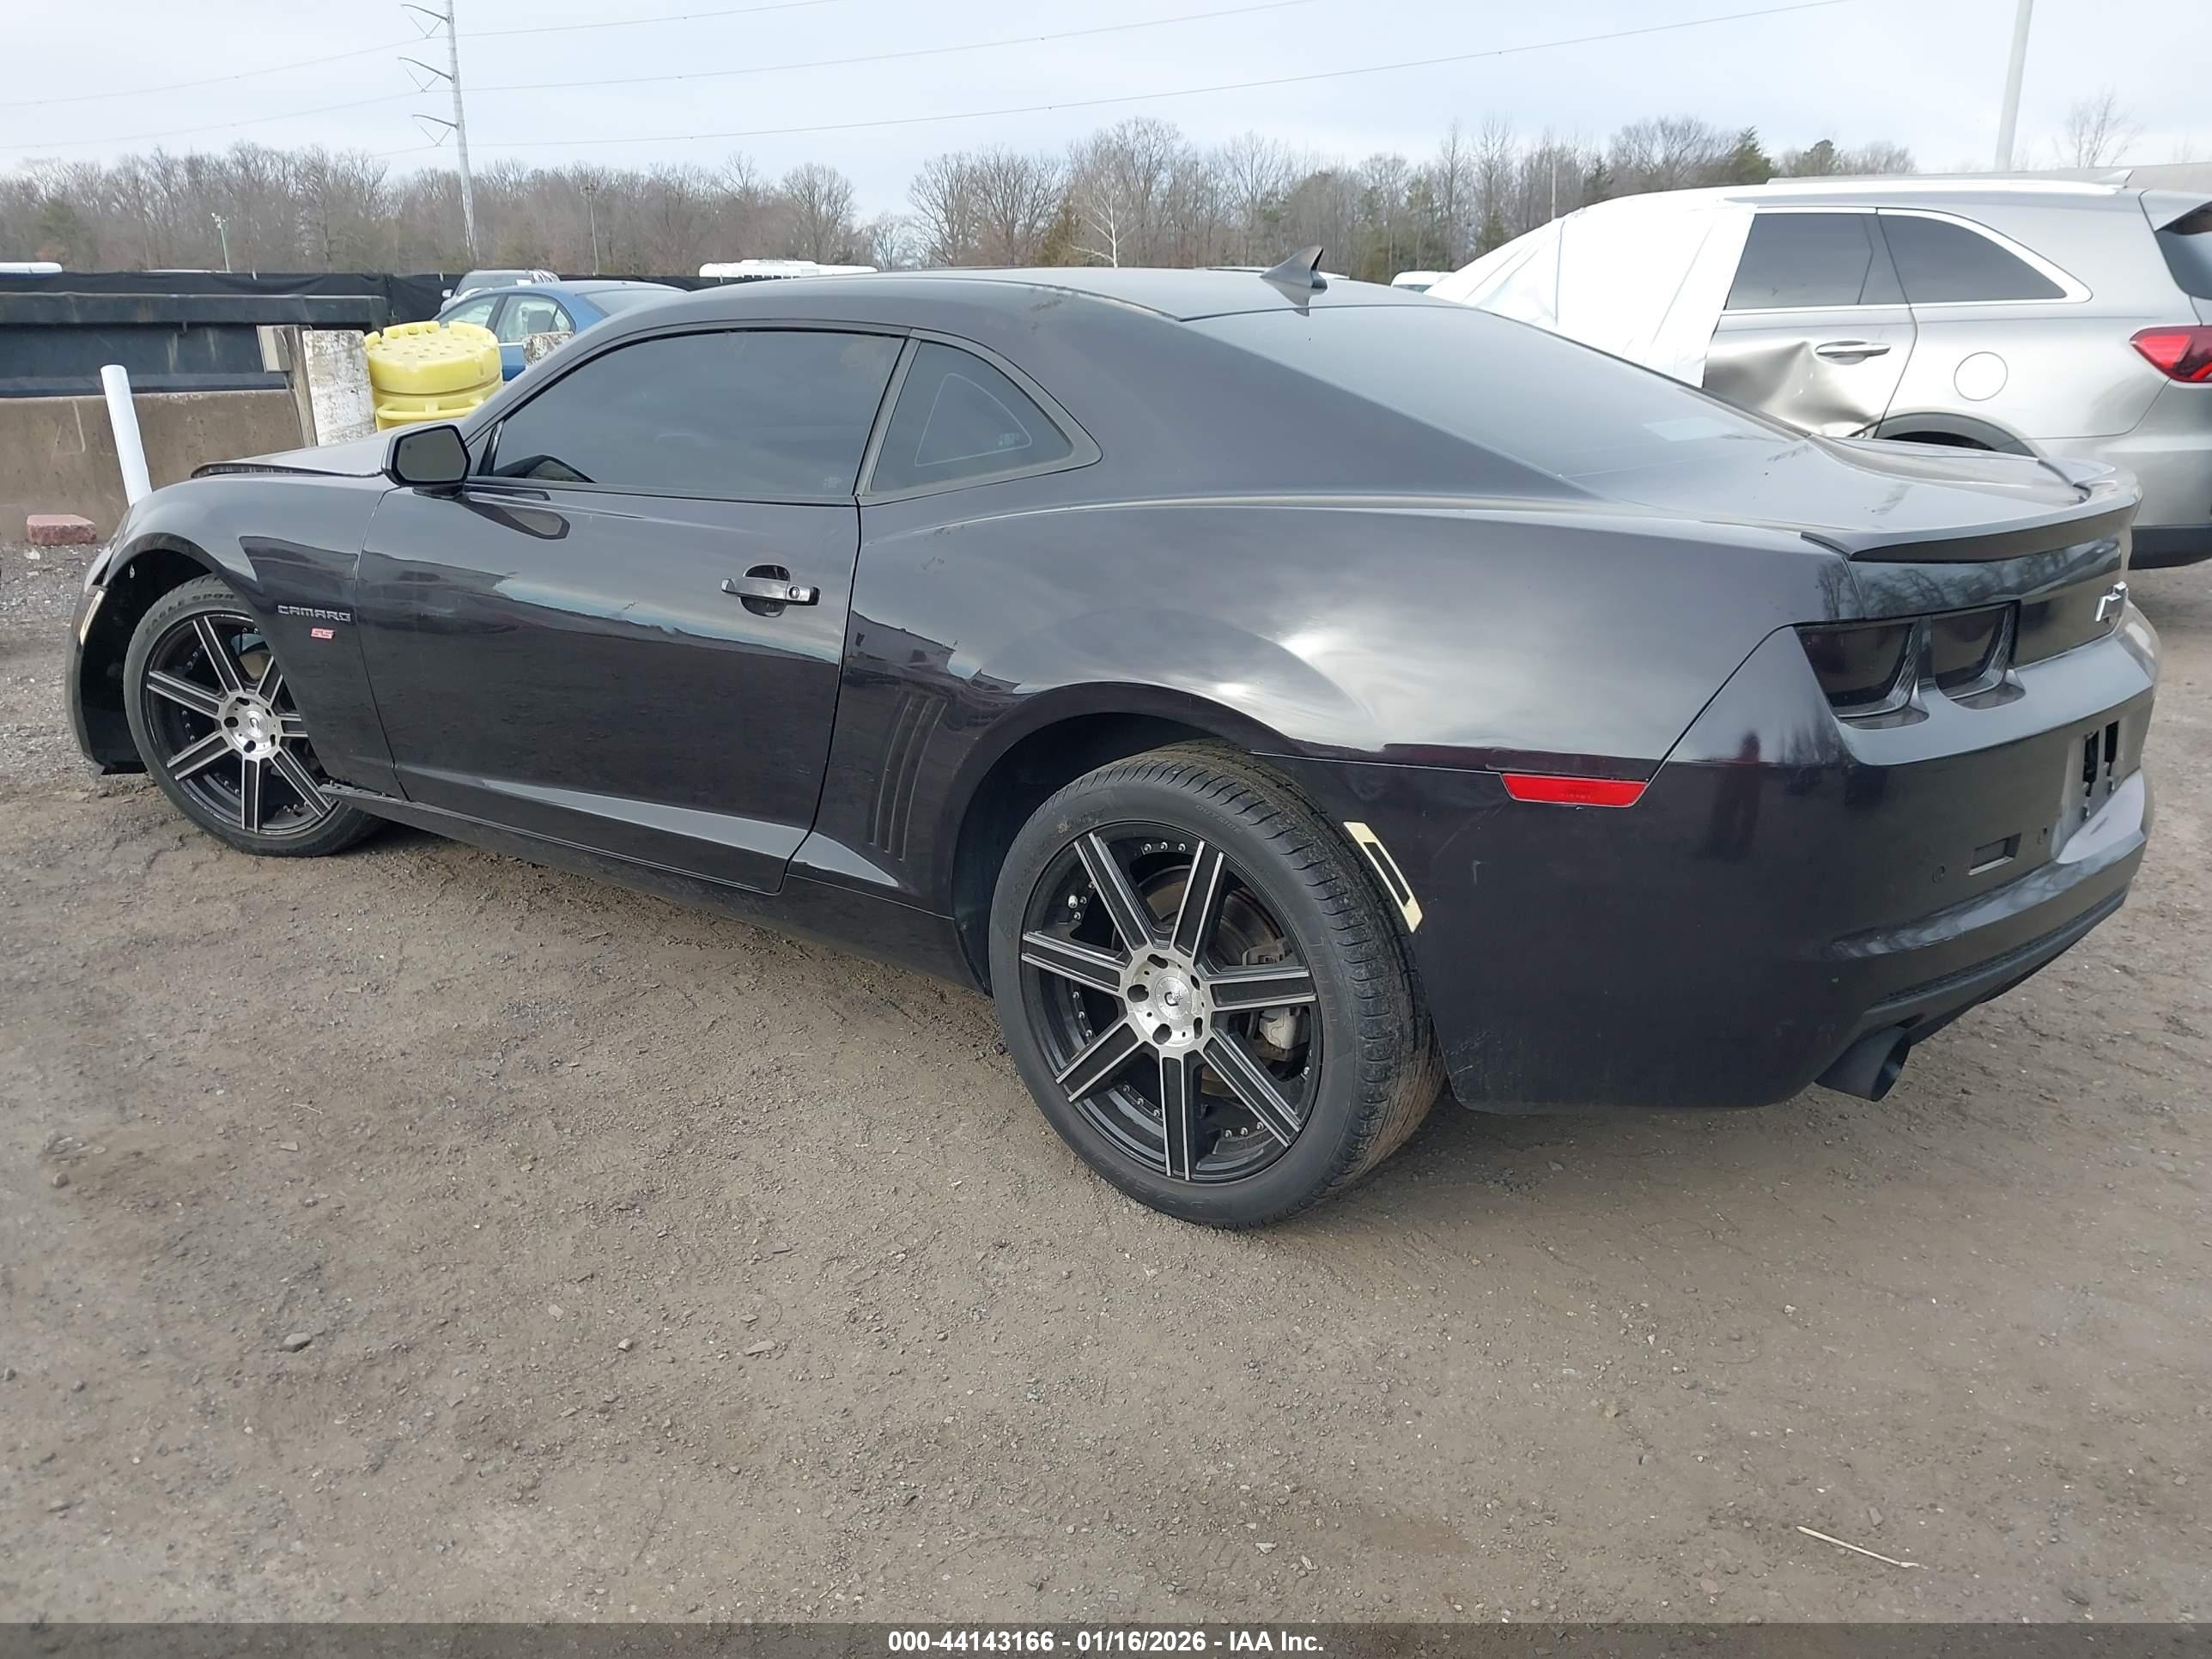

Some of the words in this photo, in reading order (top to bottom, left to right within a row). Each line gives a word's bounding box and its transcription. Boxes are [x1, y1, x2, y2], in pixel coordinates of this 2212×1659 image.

[192, 592, 234, 601] SPOR
[277, 605, 351, 623] CAMARO
[310, 628, 336, 640] SS
